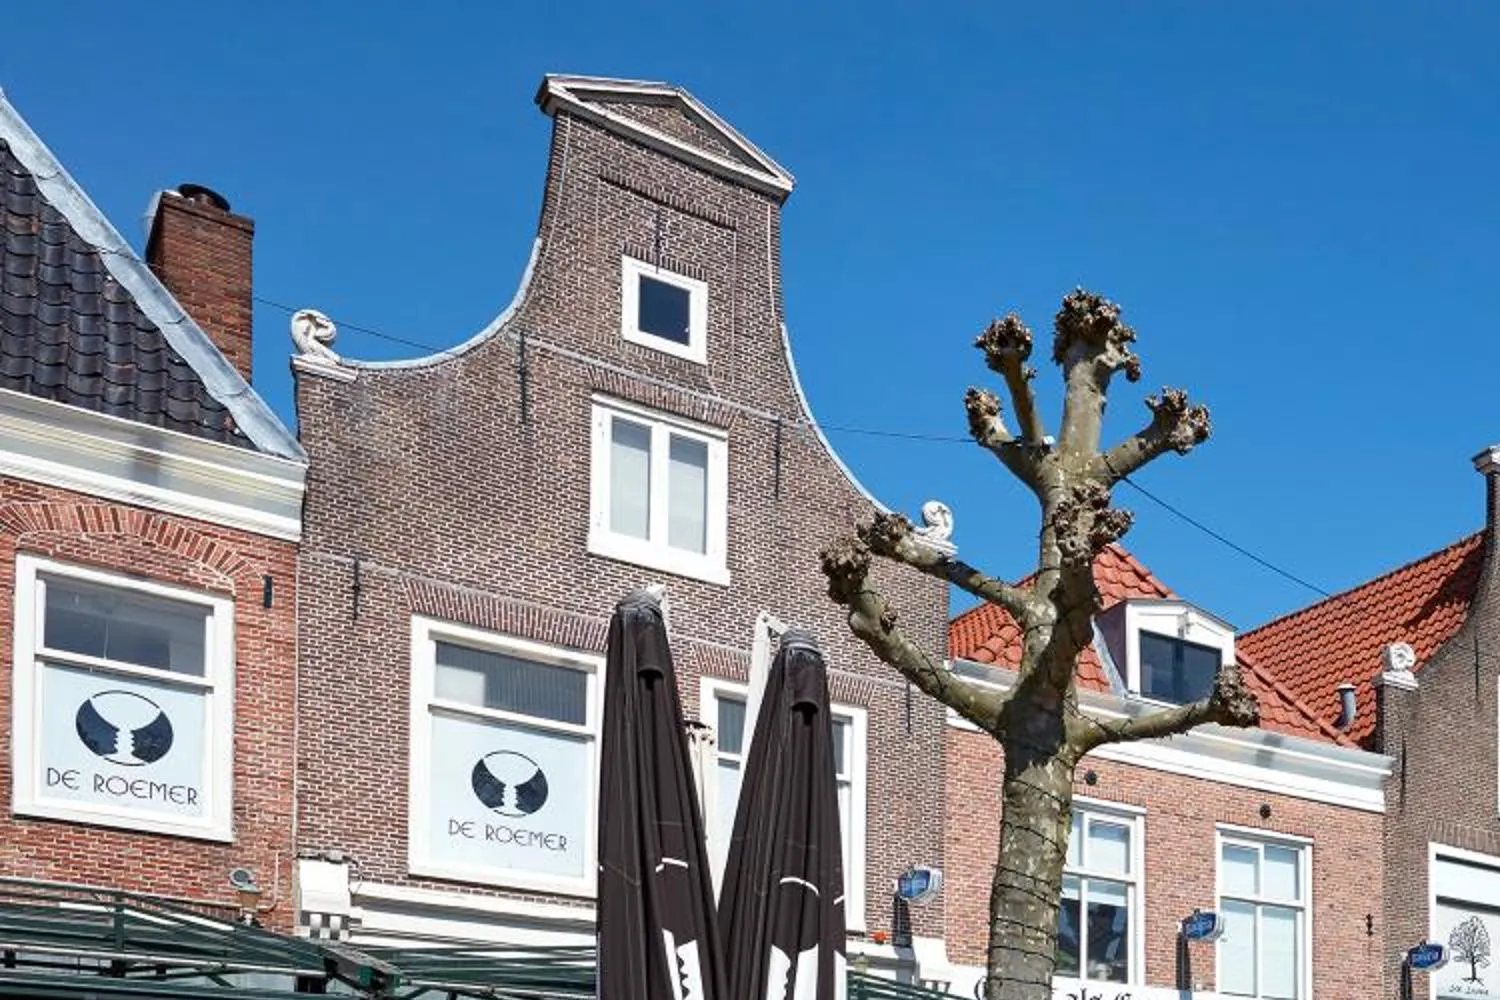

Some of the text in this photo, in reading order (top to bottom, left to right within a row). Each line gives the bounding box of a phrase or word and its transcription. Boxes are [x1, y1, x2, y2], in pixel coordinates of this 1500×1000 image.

[46, 767, 199, 806] DE ROEMER
[447, 819, 568, 852] DE ROEMER
